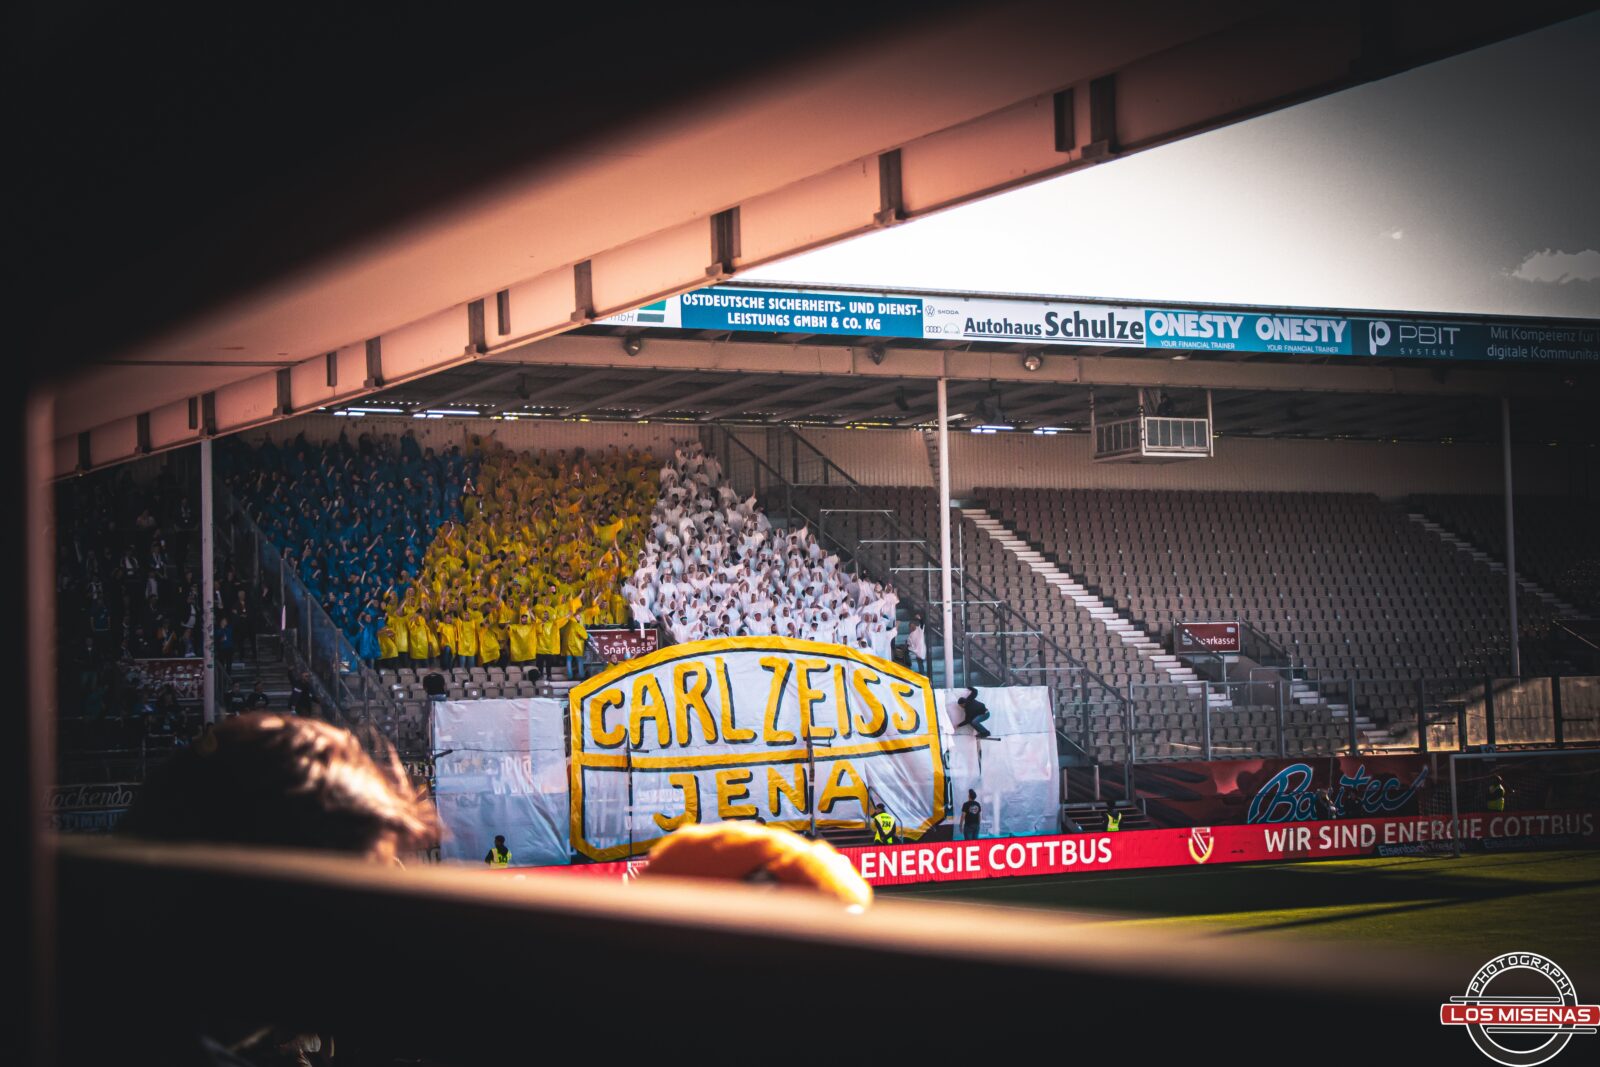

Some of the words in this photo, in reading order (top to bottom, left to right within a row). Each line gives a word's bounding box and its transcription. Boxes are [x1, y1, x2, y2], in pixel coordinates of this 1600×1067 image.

[682, 293, 765, 310] OSTDEUTSCHE
[768, 296, 846, 314] SICHERHEITS-
[848, 301, 875, 315] UND
[878, 302, 922, 317] DIENST-
[727, 312, 790, 327] LEISTUNGS
[793, 315, 827, 329] GMBH
[830, 316, 839, 329] &
[842, 317, 862, 330] CO.
[865, 318, 881, 331] KG
[965, 317, 1042, 336] Autohaus
[1044, 311, 1144, 341] Schulze
[1149, 312, 1245, 339] ONESTY
[1255, 317, 1347, 343] ONESTY
[1178, 341, 1210, 349] FINANCIAL
[1211, 342, 1236, 350] TRAINER
[1399, 325, 1461, 345] PBIT
[1490, 327, 1509, 339] Mit
[1511, 327, 1576, 345] Kompetenz
[1400, 347, 1455, 356] SYSTEME
[1487, 344, 1528, 360] digitale
[589, 657, 757, 750] CARL
[760, 655, 921, 746] ZEISS
[652, 761, 871, 833] JENA
[1264, 827, 1311, 853] WIR
[1318, 822, 1377, 850] SIND
[1384, 817, 1483, 845] ENERGIE
[1488, 814, 1595, 839] COTTBUS
[861, 846, 981, 879] ENERGIE
[988, 837, 1112, 870] COTTBUS
